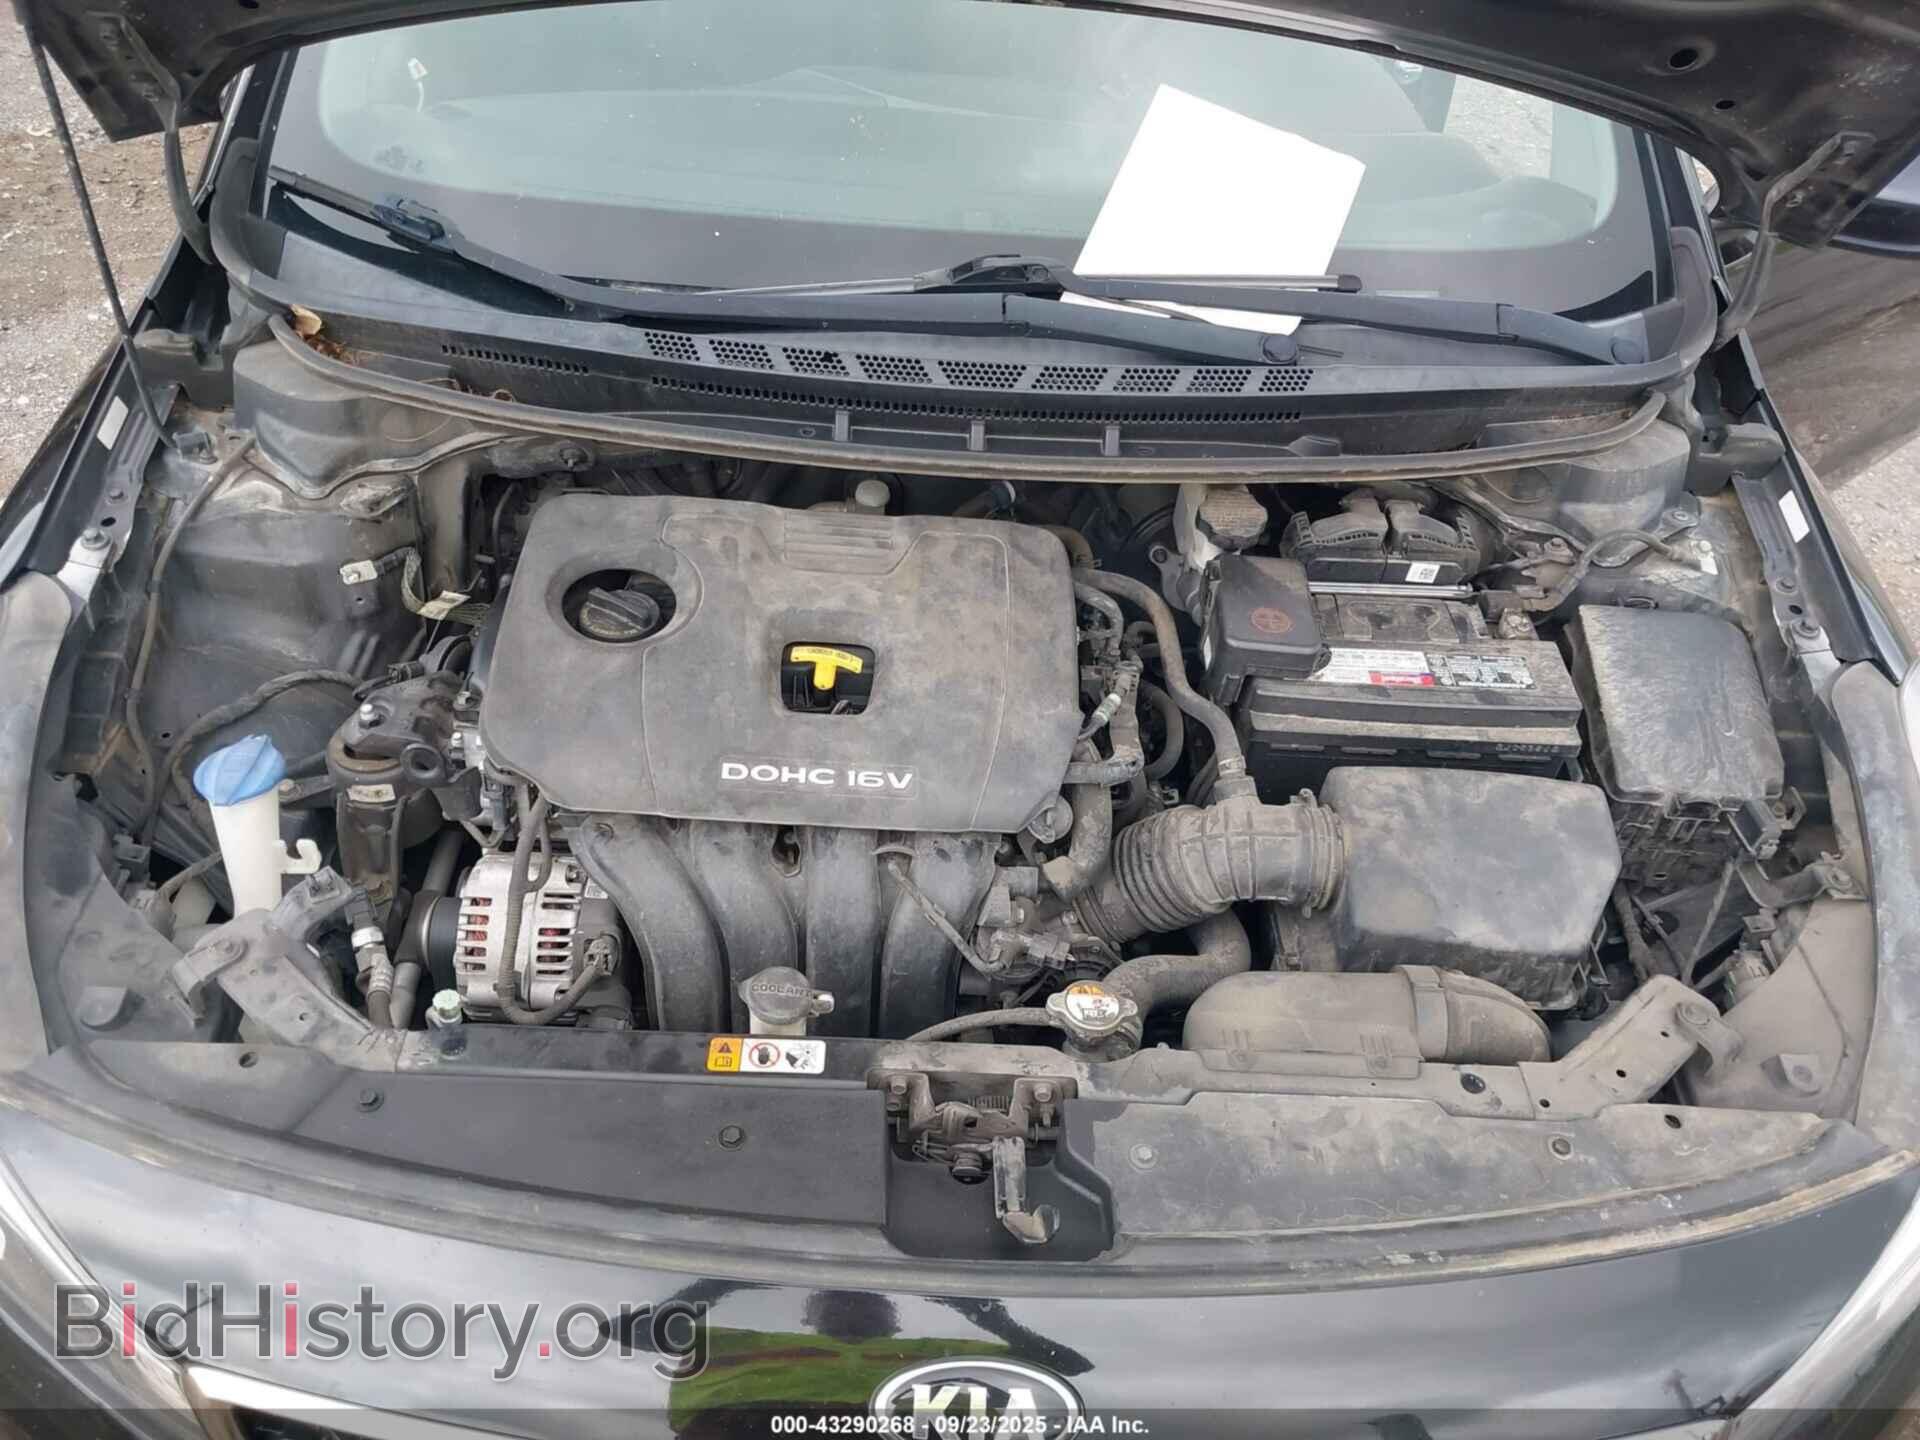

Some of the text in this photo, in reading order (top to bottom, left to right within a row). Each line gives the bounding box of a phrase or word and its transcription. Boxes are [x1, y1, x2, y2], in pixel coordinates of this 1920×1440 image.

[721, 763, 913, 789] DOHC 16V
[751, 983, 813, 998] COOLANT
[911, 1384, 1048, 1440] KIA
